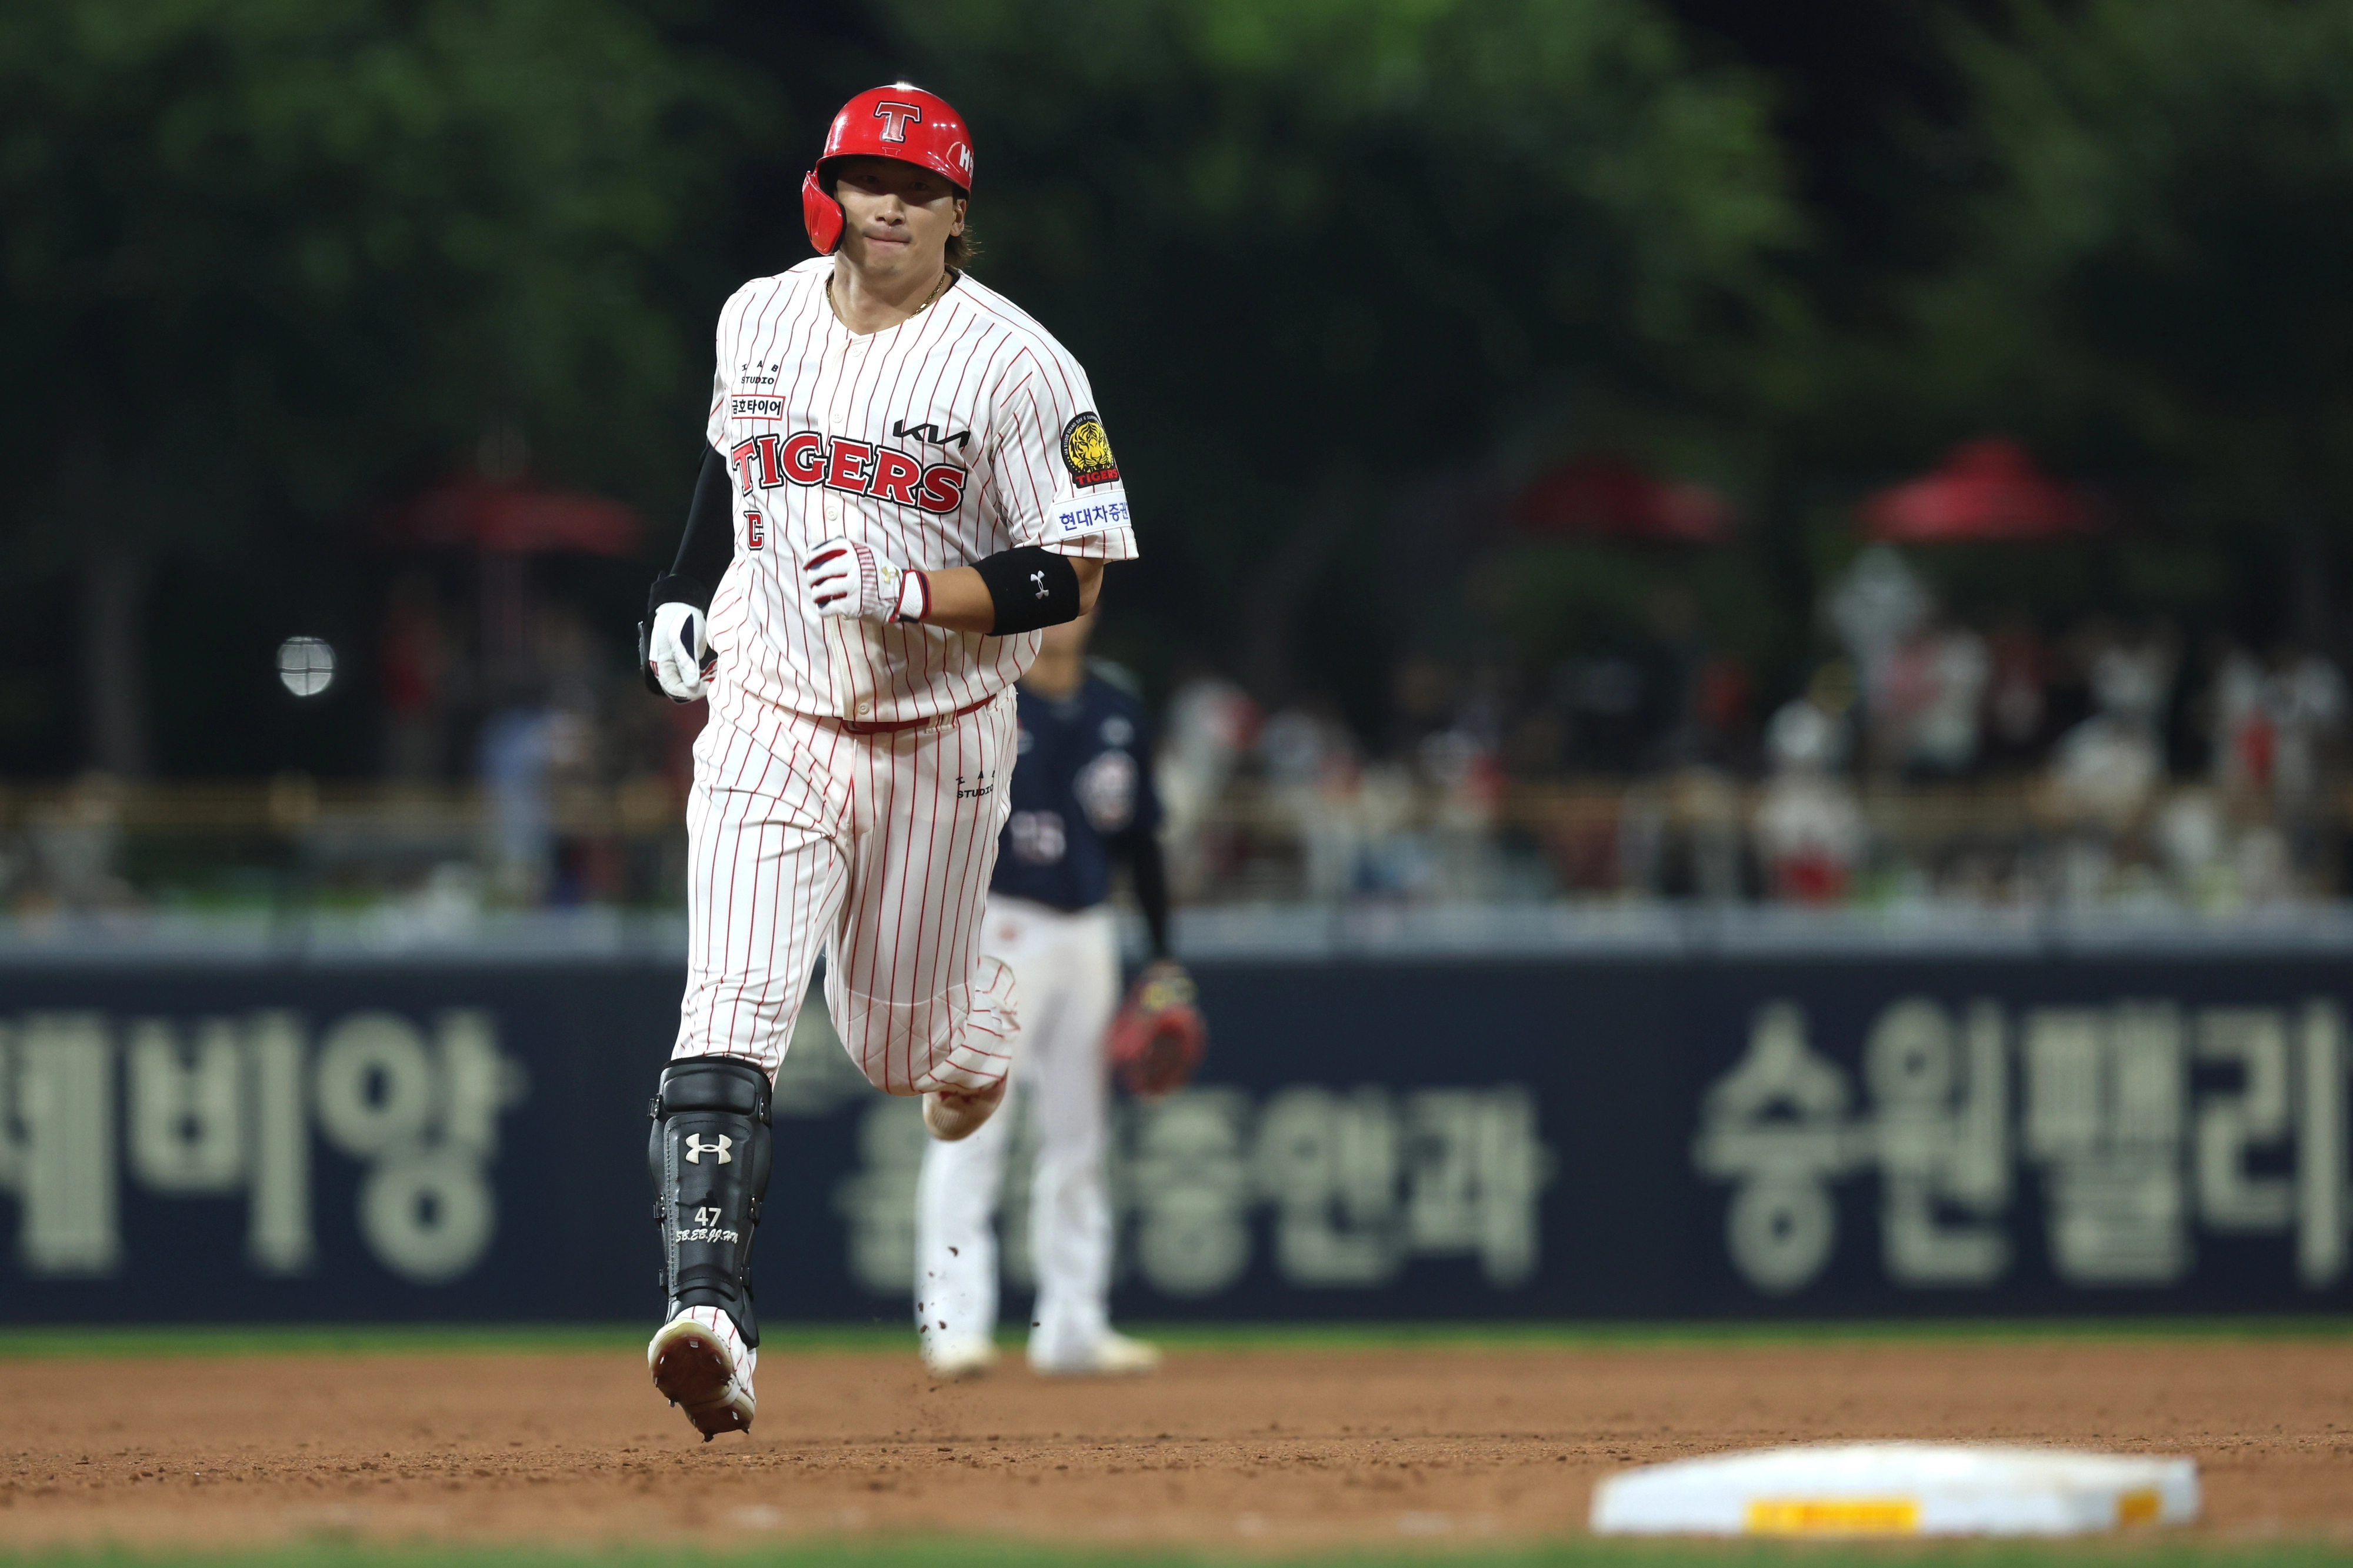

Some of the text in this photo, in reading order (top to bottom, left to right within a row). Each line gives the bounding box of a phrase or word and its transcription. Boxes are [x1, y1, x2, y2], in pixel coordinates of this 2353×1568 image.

[874, 101, 922, 144] T
[741, 376, 775, 385] STUDIO
[732, 399, 782, 416] 금호타이어
[1067, 422, 1076, 435] BRAND
[731, 430, 968, 515] TIGERS
[1075, 468, 1118, 485] TIGERS
[1059, 502, 1129, 532] 현대차증권
[744, 511, 764, 551] C
[956, 784, 994, 799] STUDIO
[694, 1206, 722, 1227] 47
